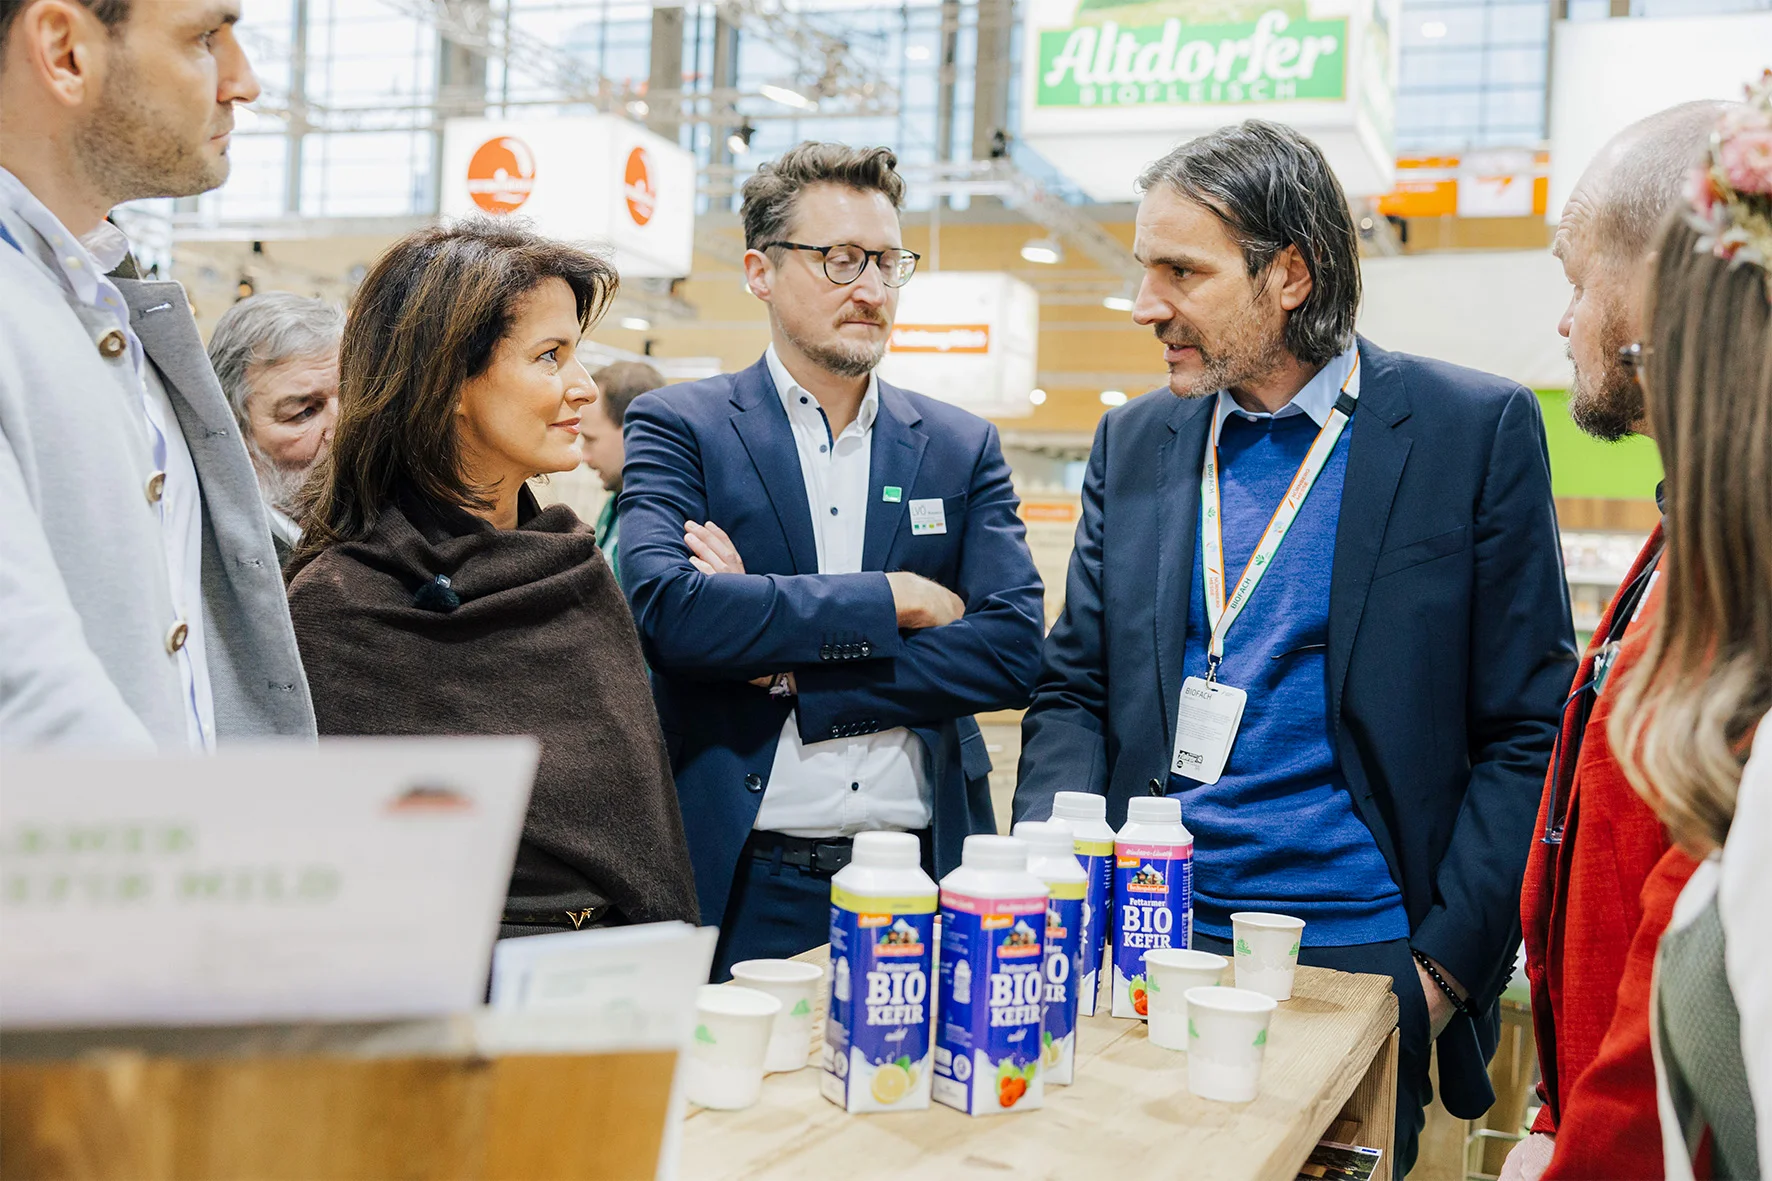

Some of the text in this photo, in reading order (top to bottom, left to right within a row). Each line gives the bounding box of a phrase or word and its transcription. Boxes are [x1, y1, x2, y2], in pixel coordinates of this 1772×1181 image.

[1044, 9, 1338, 87] Altdorfer
[1230, 577, 1252, 610] BIOFACH
[1185, 687, 1212, 700] BIOFACH
[1129, 898, 1166, 907] Fettarmer
[1122, 905, 1173, 934] BIO
[1123, 932, 1172, 949] KEFIR
[865, 971, 927, 1006] BIO
[989, 971, 1043, 1007] BIO
[866, 1004, 925, 1026] KEFIR
[990, 1004, 1041, 1027] KEFIR
